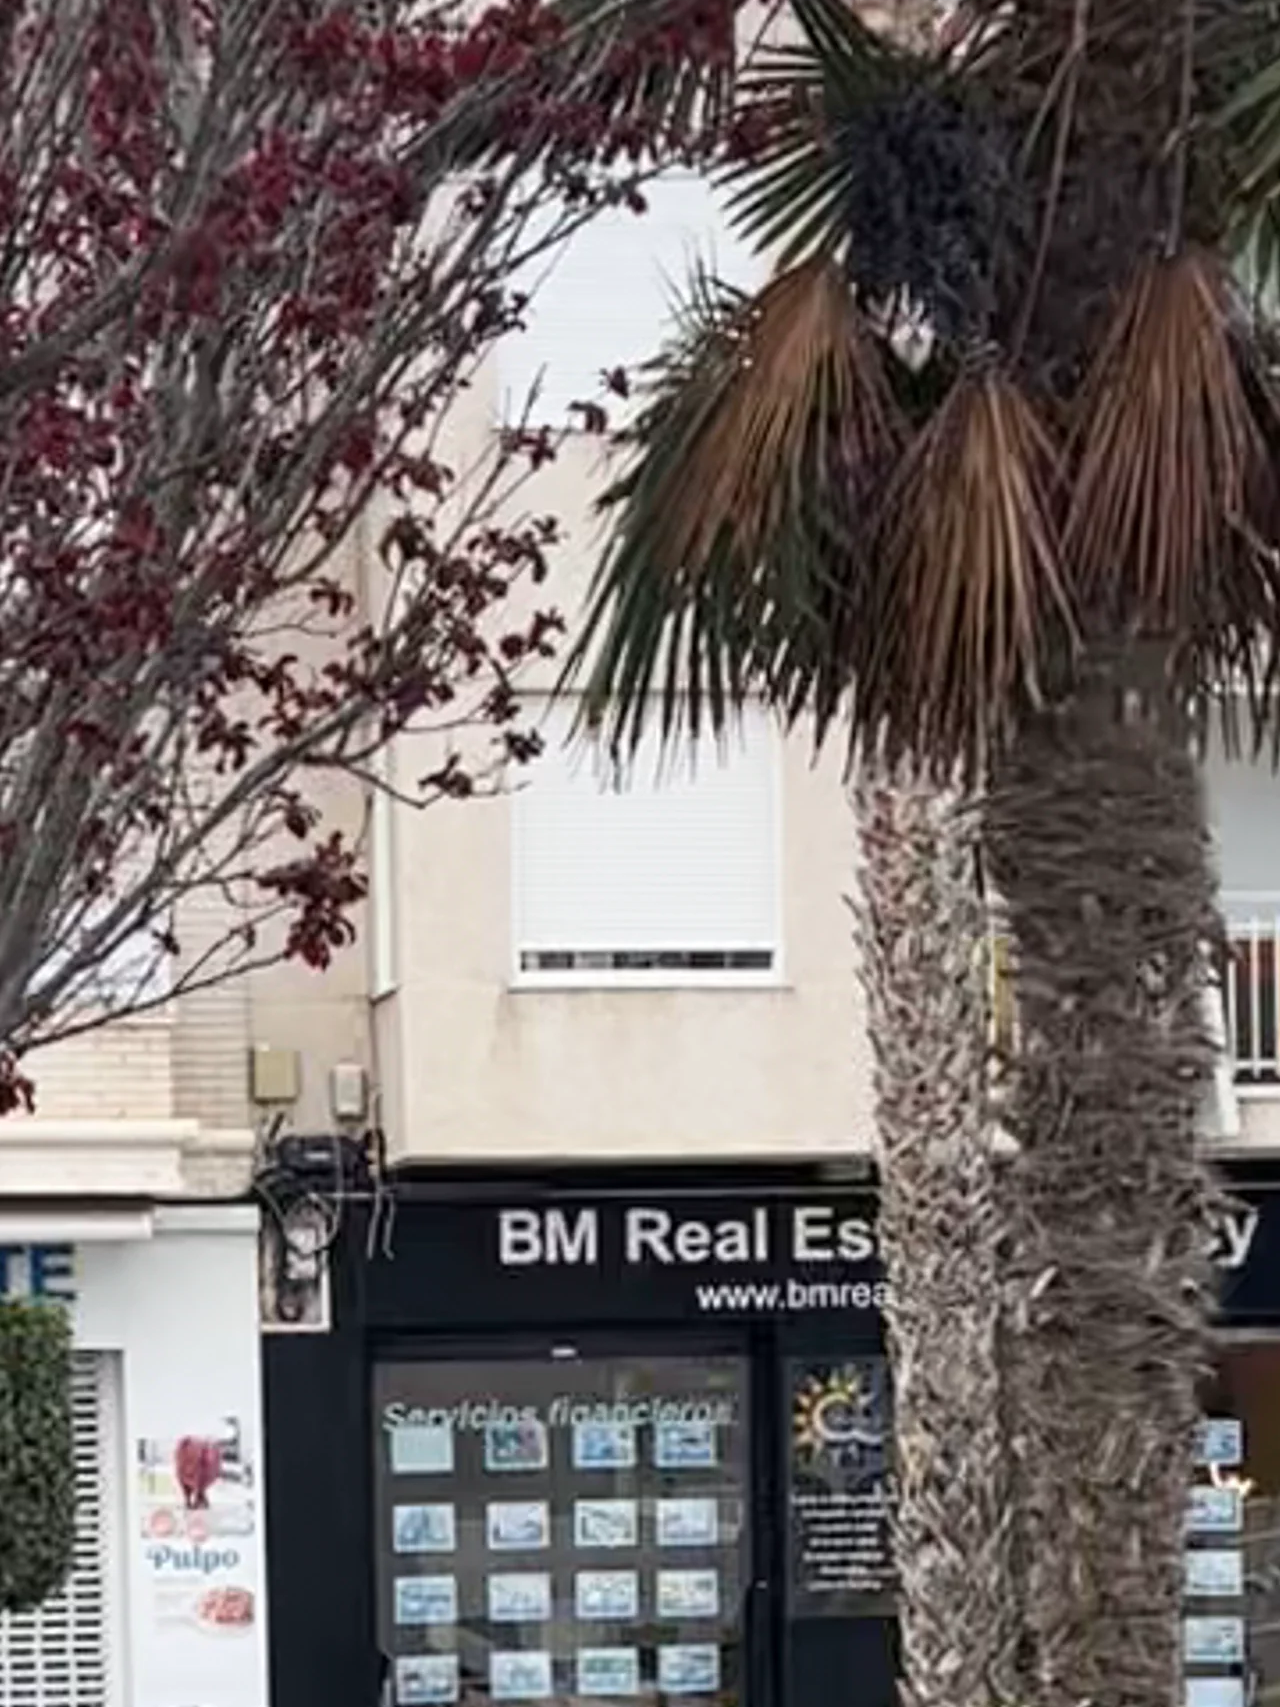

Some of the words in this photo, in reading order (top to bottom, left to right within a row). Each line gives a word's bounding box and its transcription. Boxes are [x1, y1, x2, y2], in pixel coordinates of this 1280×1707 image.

[499, 1208, 598, 1265] BM
[625, 1206, 769, 1263] Real
[794, 1205, 874, 1261] Es
[695, 1278, 893, 1309] www.bmrea
[145, 1544, 240, 1574] Pulpo
